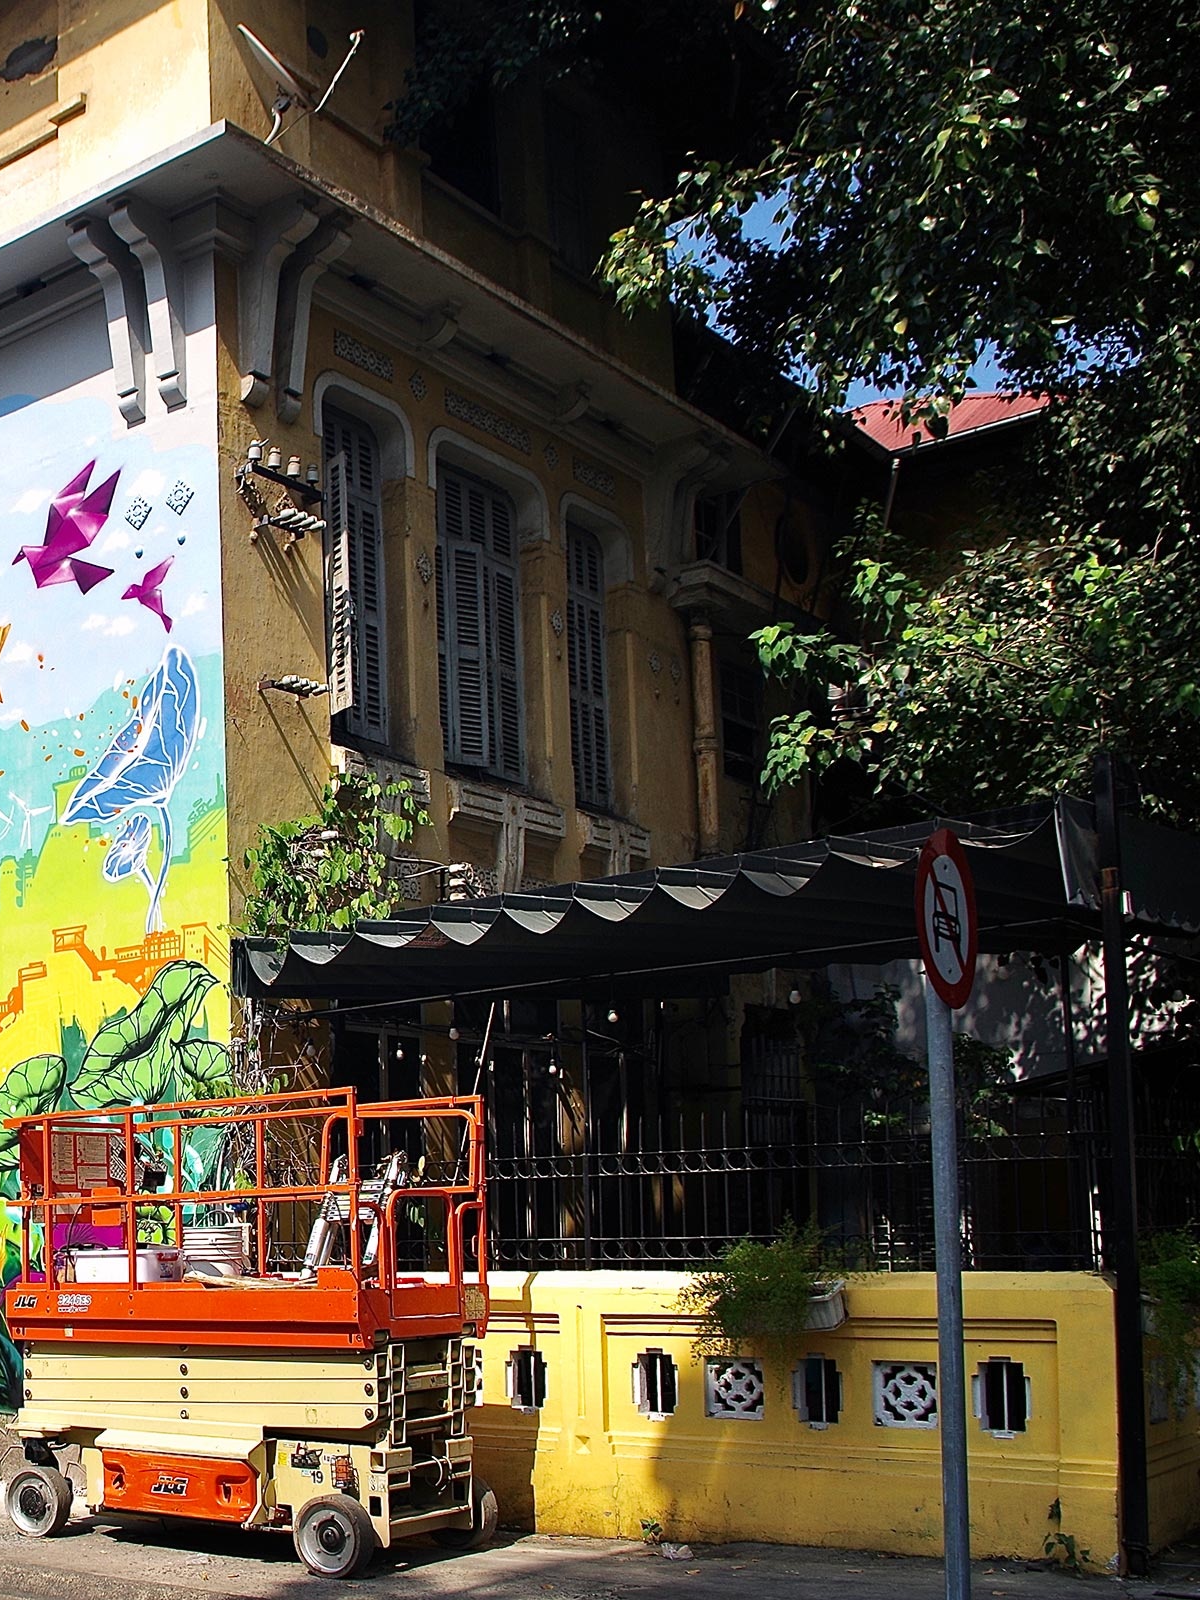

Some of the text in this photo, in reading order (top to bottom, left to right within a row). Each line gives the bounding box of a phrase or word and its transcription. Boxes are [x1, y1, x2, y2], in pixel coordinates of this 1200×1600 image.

[14, 1295, 37, 1308] JLG
[58, 1294, 91, 1306] 3246ES
[310, 1470, 324, 1484] 19
[151, 1475, 188, 1496] JLG
